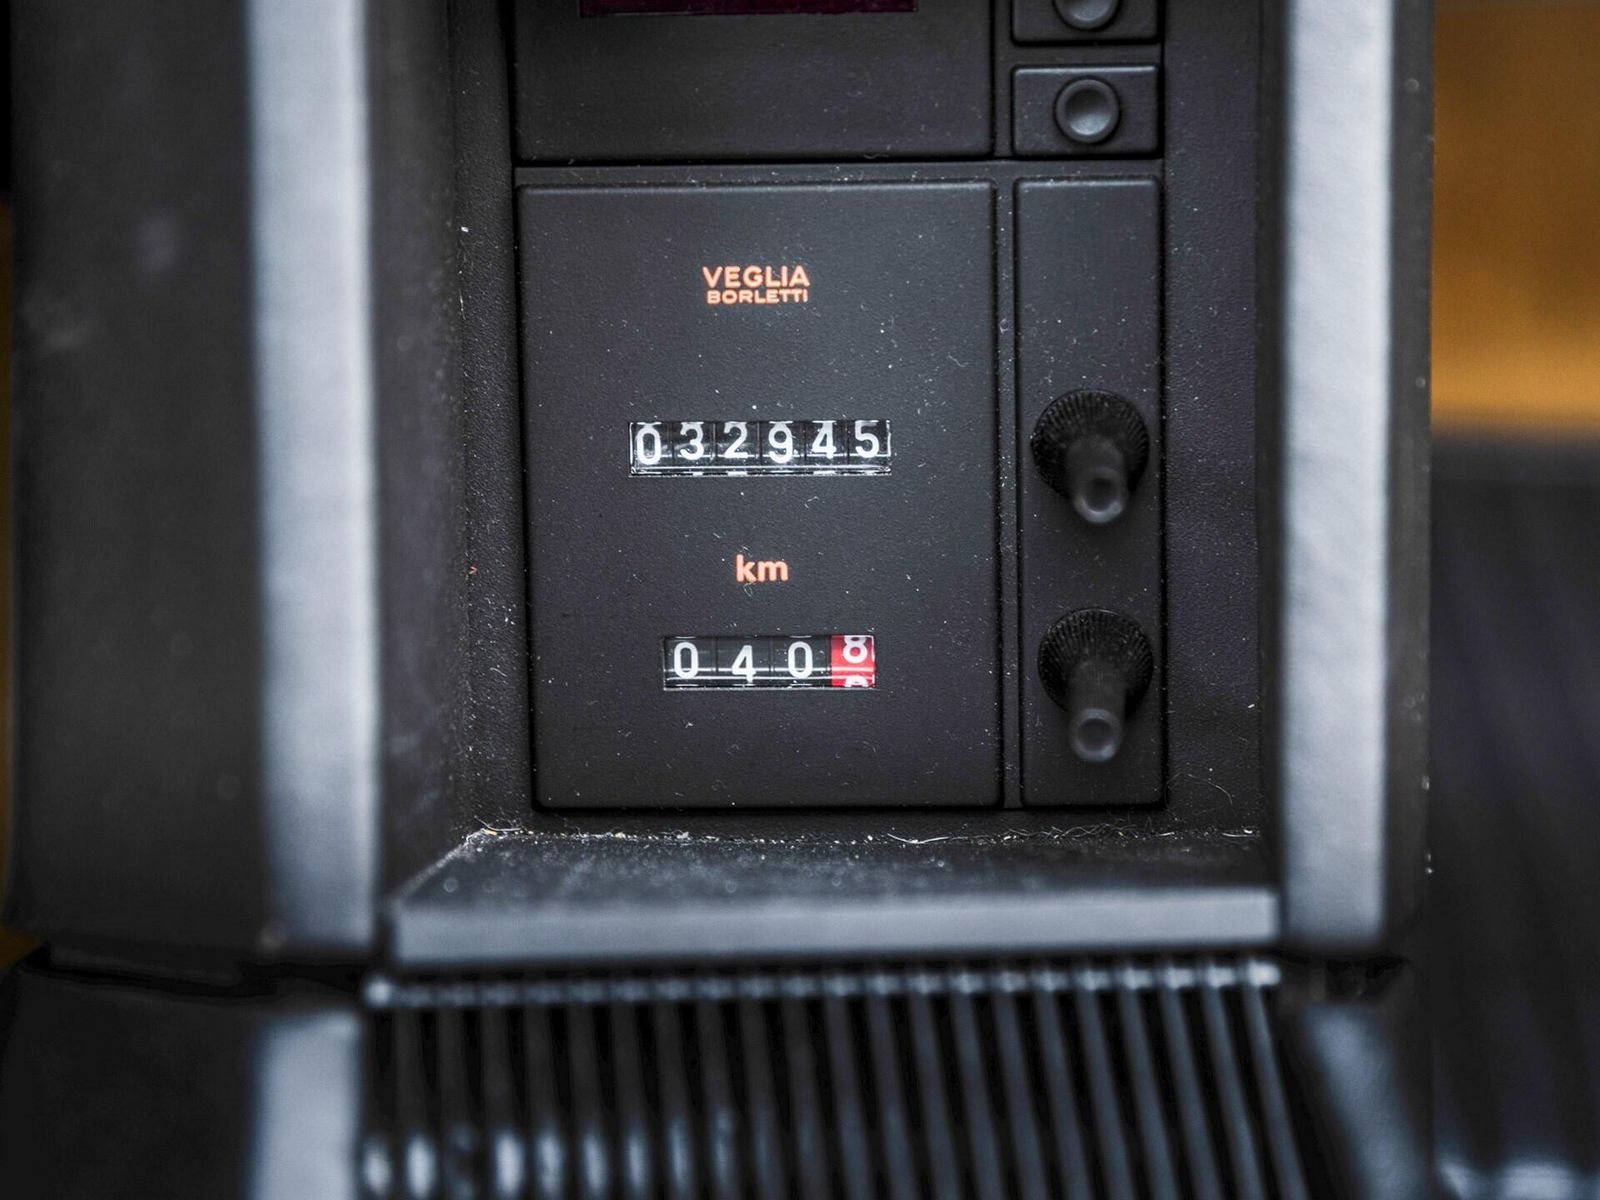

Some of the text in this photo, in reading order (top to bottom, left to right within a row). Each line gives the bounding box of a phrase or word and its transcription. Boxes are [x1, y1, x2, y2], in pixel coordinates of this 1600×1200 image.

[702, 265, 811, 288] VEGLIA
[706, 289, 809, 304] BORLETTI
[635, 421, 880, 465] 032945
[735, 554, 789, 582] km
